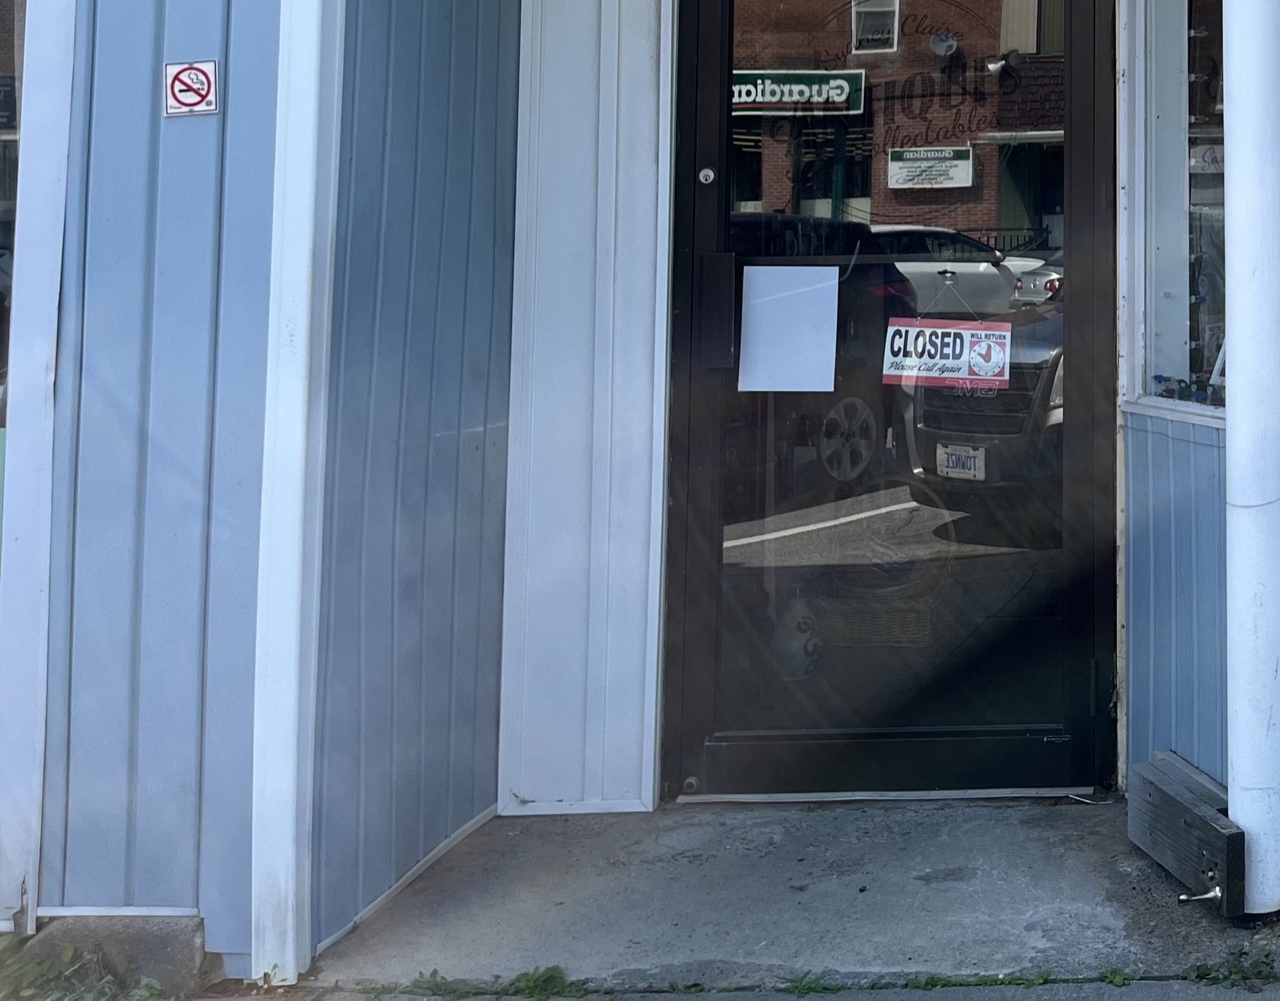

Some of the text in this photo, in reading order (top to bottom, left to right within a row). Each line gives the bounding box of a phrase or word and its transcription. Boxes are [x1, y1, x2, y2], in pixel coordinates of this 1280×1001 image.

[900, 14, 965, 42] Claire
[866, 105, 1000, 157] ollectables
[890, 329, 965, 360] CLOSED
[888, 361, 962, 376] Please Call Again
